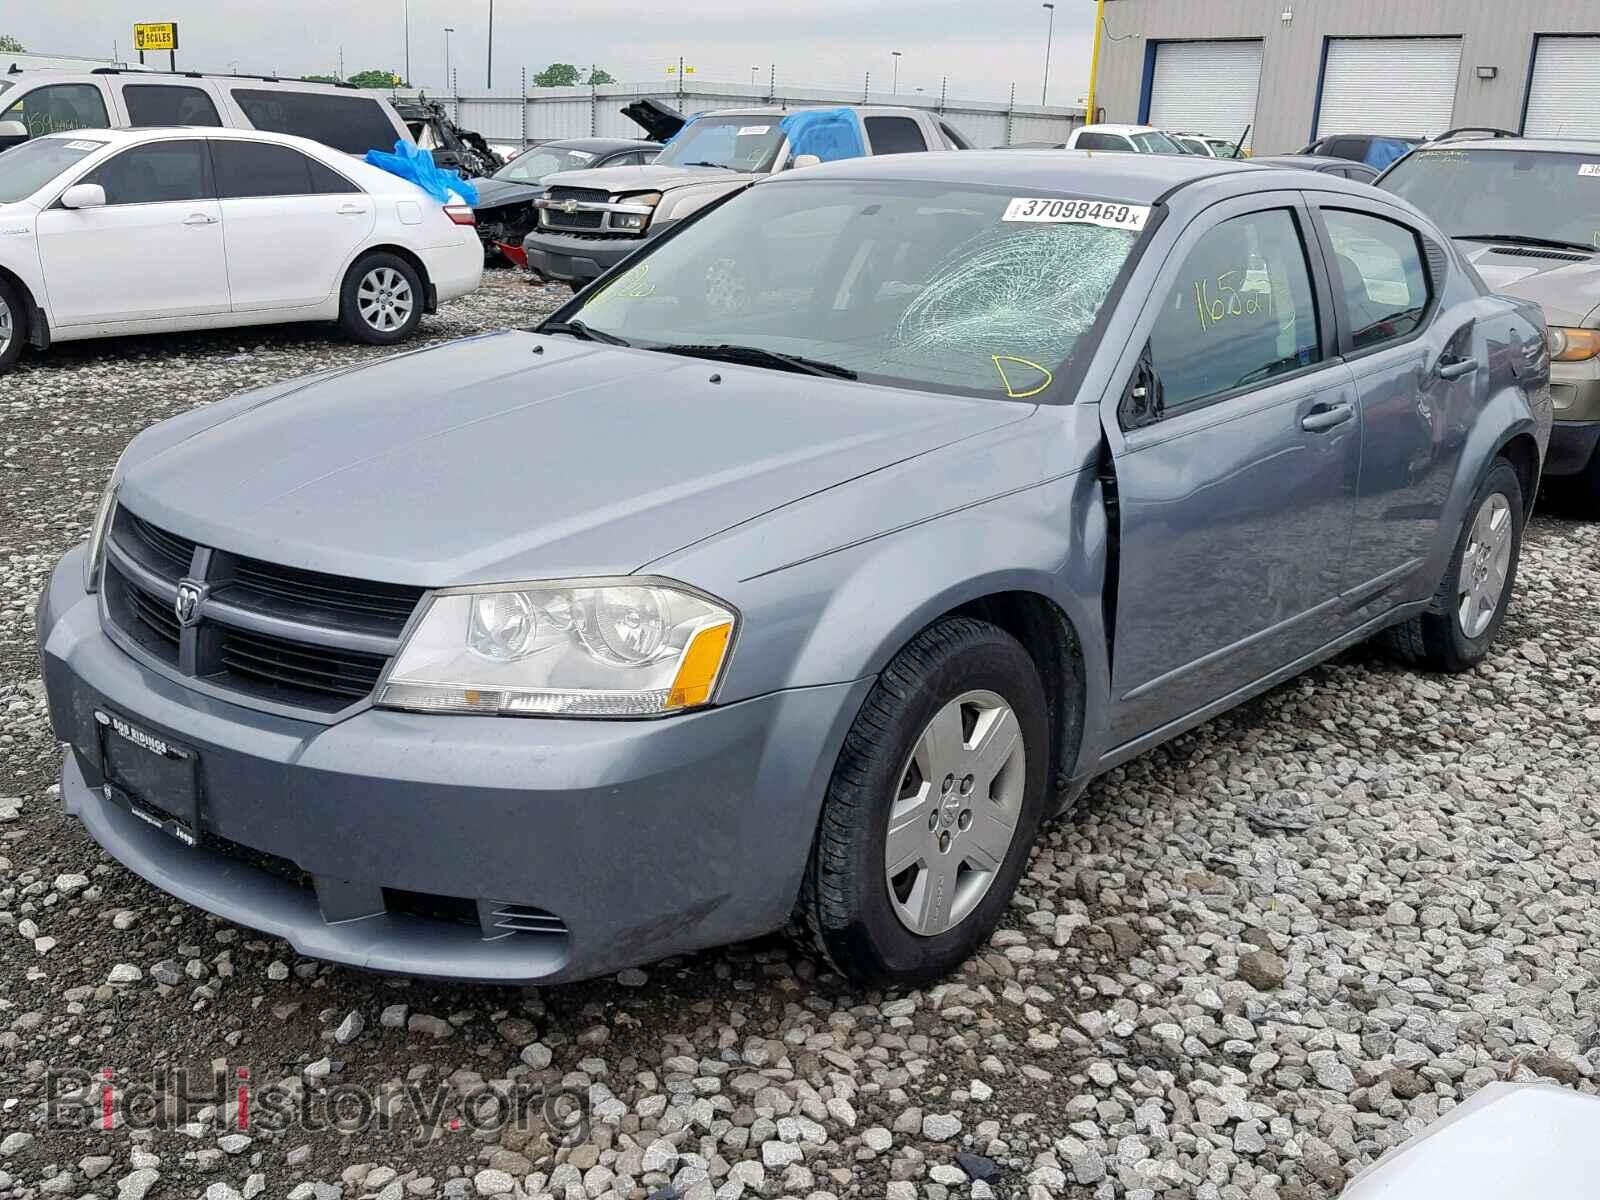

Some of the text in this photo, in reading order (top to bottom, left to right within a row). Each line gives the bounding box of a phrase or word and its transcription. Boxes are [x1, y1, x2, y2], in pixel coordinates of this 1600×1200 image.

[146, 32, 171, 43] SCALES
[1022, 199, 1130, 223] 37098469
[991, 354, 1052, 398] D
[130, 727, 167, 754] RIDINGS
[175, 826, 193, 846] Jeep
